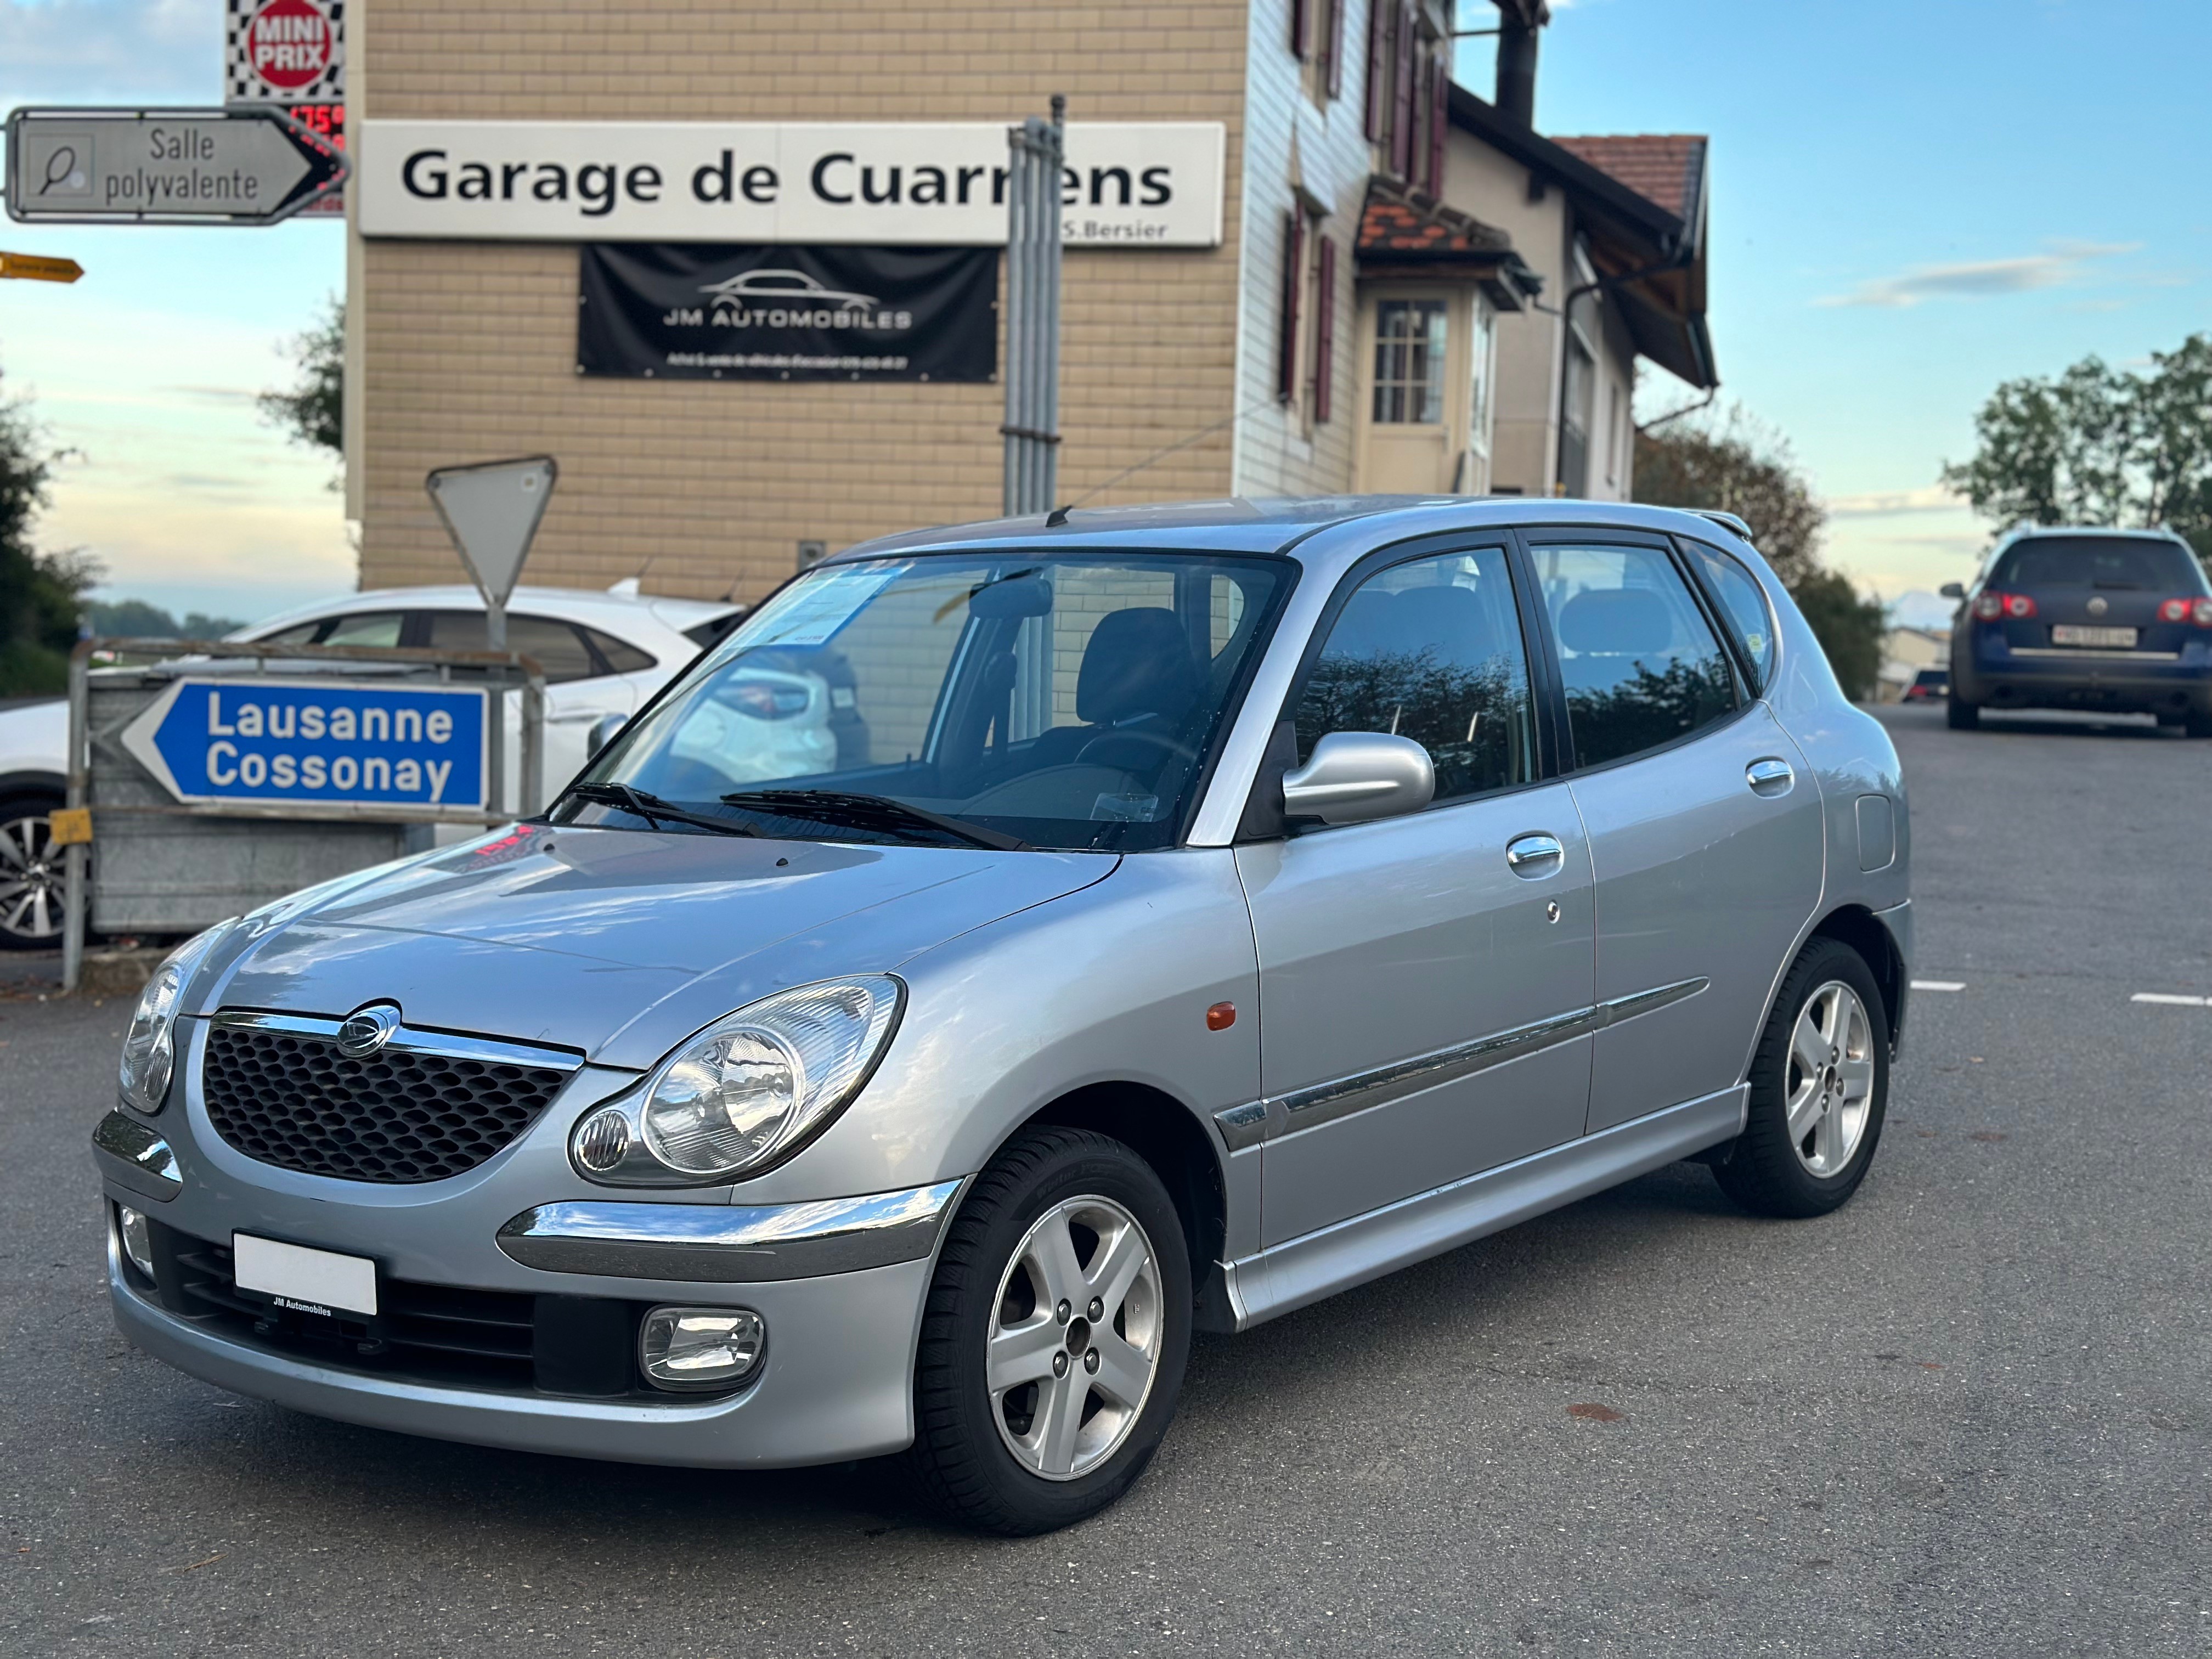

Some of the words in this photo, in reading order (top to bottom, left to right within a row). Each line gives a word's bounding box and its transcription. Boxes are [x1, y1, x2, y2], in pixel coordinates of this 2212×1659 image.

[256, 15, 324, 42] MINI
[256, 44, 325, 71] PRIX
[150, 128, 215, 160] Salle
[106, 168, 258, 206] polyvalente
[402, 150, 662, 217] Garage
[692, 149, 779, 204] de
[1063, 220, 1167, 239] S.Bersier
[663, 308, 703, 326] JM
[712, 308, 912, 330] AUTOMOBILES
[208, 692, 454, 742] Lausanne
[207, 741, 453, 803] Cossonay
[273, 1296, 284, 1306] JM
[286, 1300, 331, 1317] Automobiles
